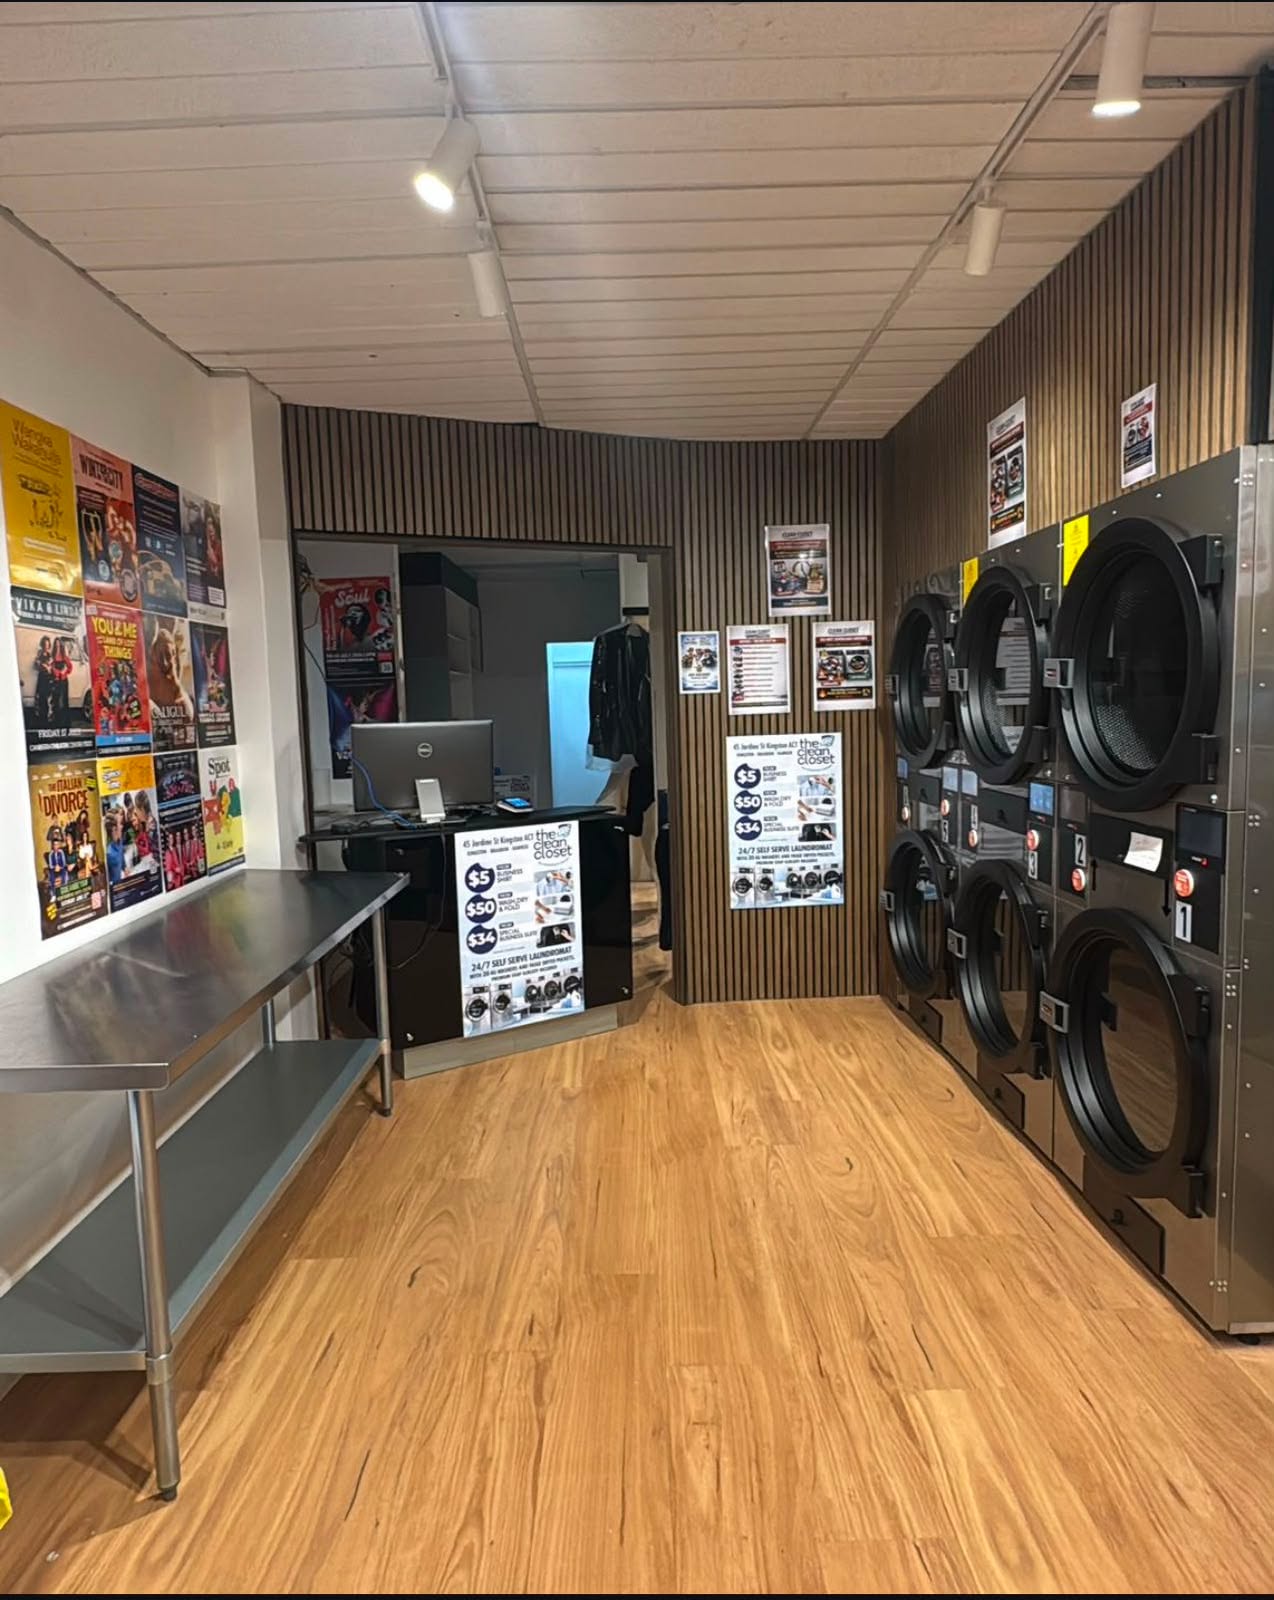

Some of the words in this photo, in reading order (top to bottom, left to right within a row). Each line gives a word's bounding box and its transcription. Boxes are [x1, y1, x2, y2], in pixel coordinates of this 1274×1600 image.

[16, 597, 44, 612] VIKA
[91, 616, 113, 636] YOU
[124, 622, 137, 638] ME
[104, 646, 132, 659] THINGS
[800, 738, 819, 748] the
[797, 747, 830, 757] clean
[798, 754, 835, 765] closet
[208, 758, 230, 778] Spot
[737, 769, 756, 784] $5
[57, 778, 82, 791] ITALIAN
[44, 790, 88, 816] DIVORCE
[735, 796, 760, 809] $50
[536, 828, 556, 841] the
[736, 822, 760, 834] $34
[534, 838, 567, 850] clean
[772, 845, 789, 853] SERVE
[792, 844, 832, 852] LAUNDROMAT
[1078, 838, 1084, 863] 2
[534, 846, 572, 860] closet
[1030, 855, 1035, 877] 3
[468, 870, 490, 888] $5
[467, 901, 495, 917] $50
[1181, 906, 1187, 938] 1
[468, 931, 496, 947] $34
[472, 961, 490, 972] 24/7
[492, 958, 507, 967] SELF
[508, 955, 528, 964] SERVE
[529, 946, 572, 960] LAUNDROMAT
